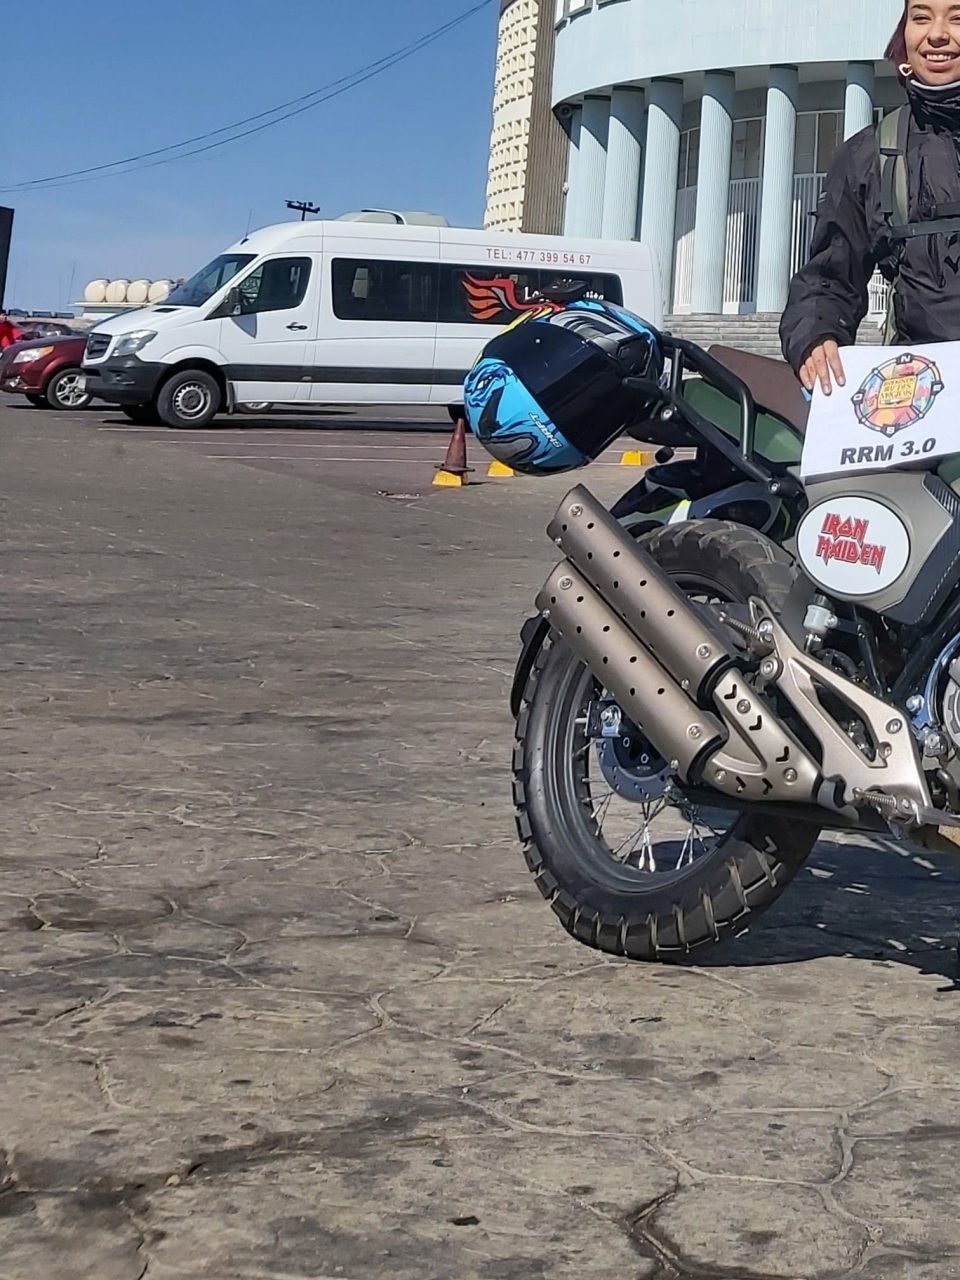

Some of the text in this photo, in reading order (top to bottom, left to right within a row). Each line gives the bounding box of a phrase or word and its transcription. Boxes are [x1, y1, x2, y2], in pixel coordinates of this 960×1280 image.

[487, 248, 591, 265] TEL: 477 399 54 67
[901, 355, 911, 363] N
[840, 438, 936, 465] RRM 3.0
[821, 512, 869, 547] IRON
[816, 535, 886, 575] MAIDEN
